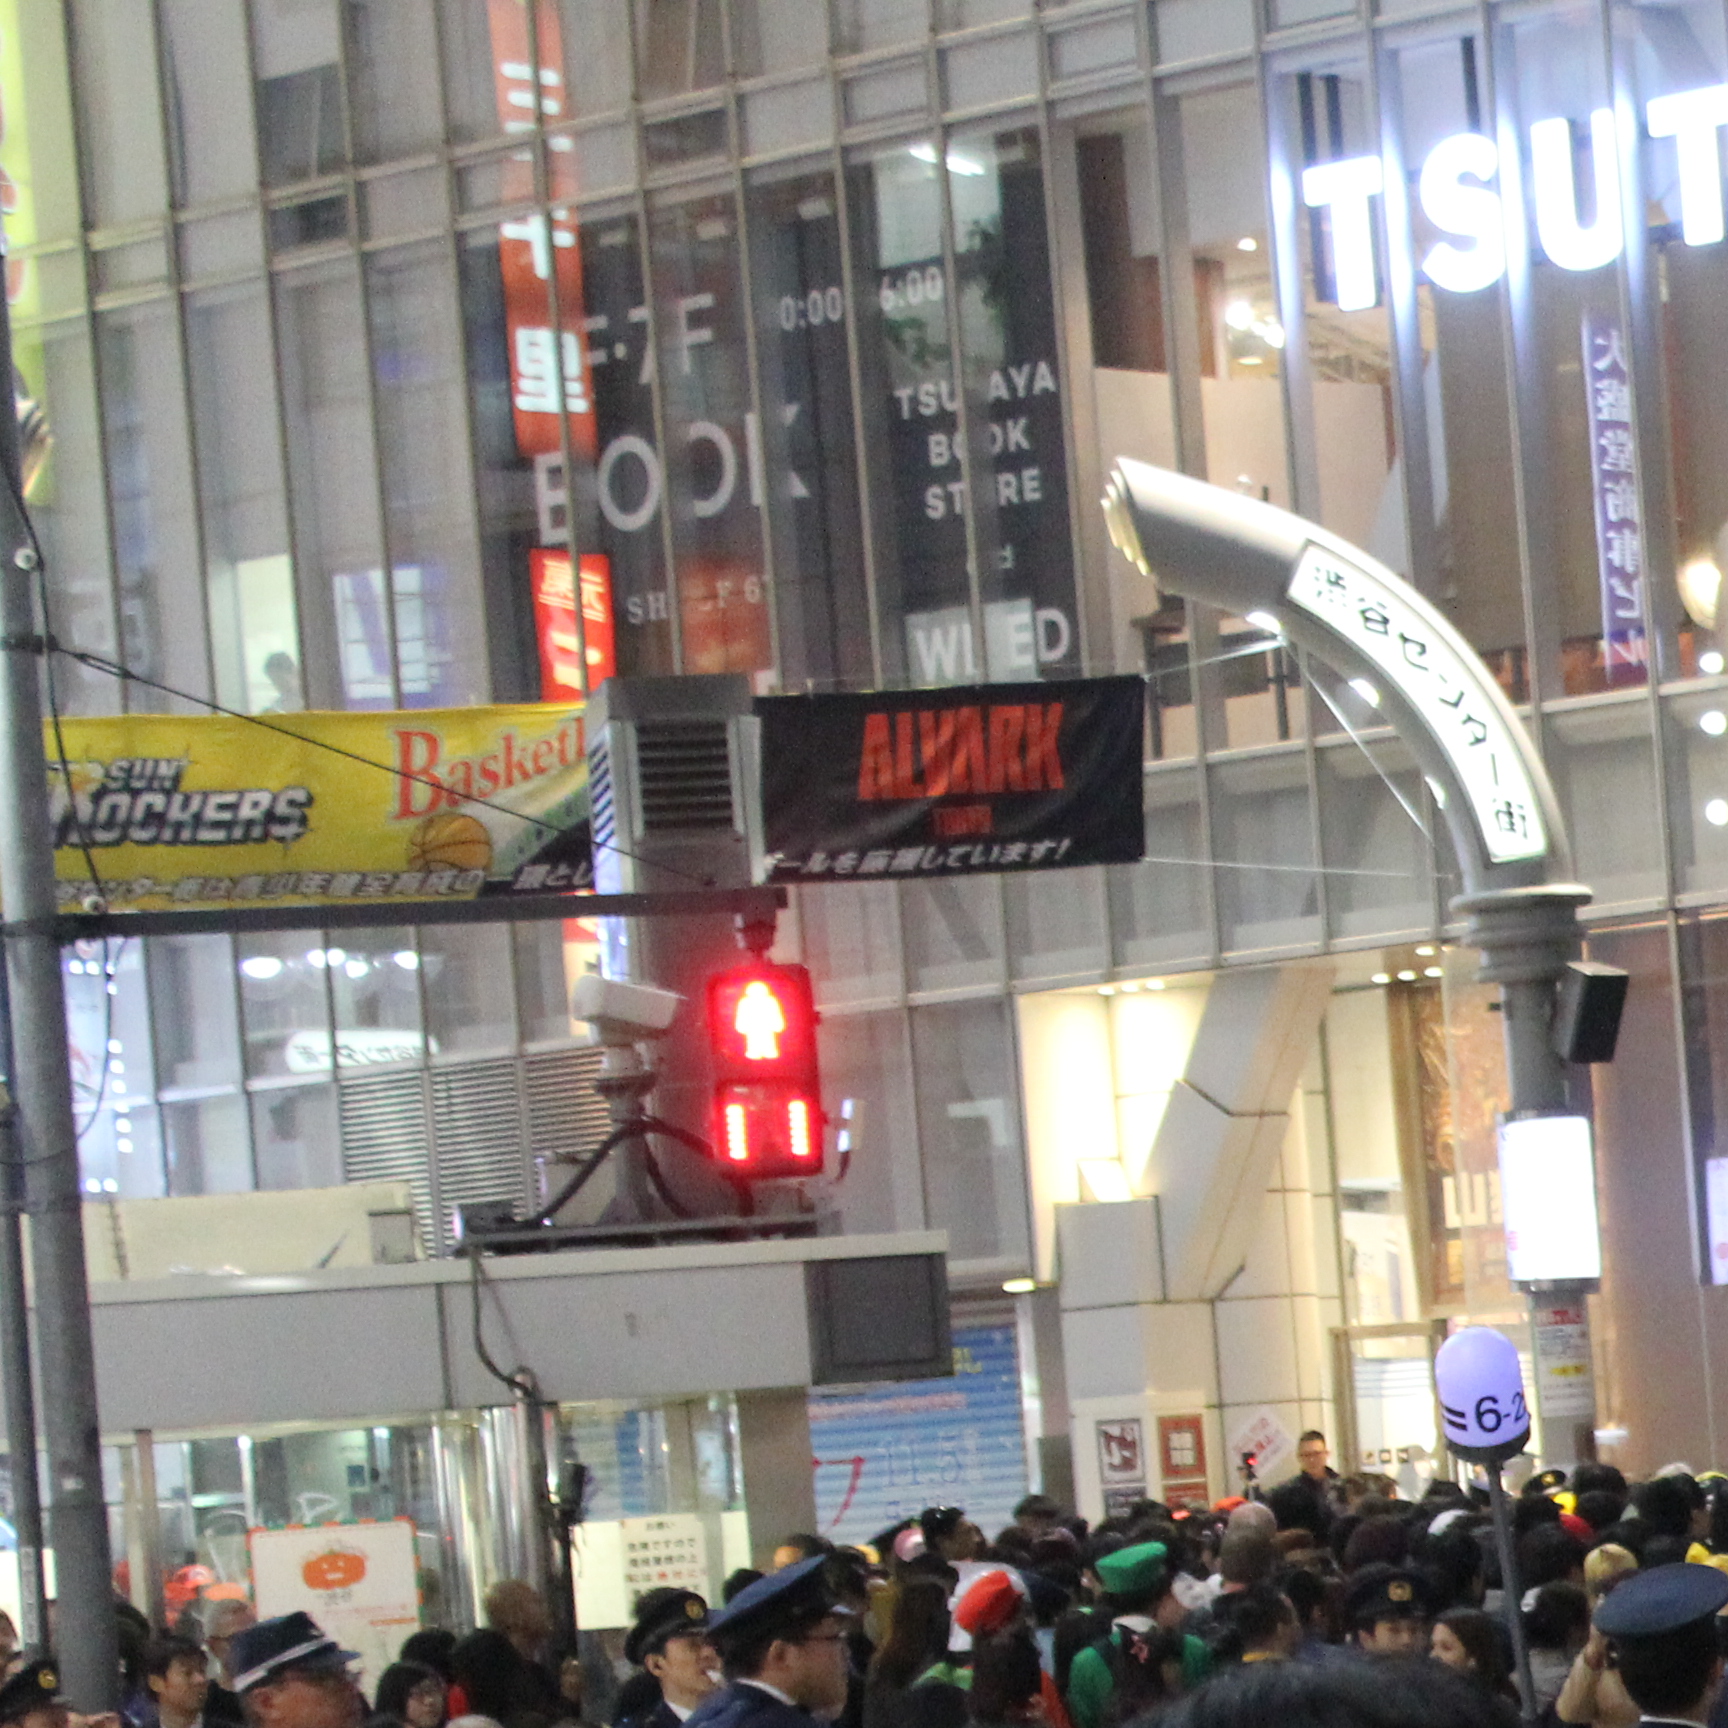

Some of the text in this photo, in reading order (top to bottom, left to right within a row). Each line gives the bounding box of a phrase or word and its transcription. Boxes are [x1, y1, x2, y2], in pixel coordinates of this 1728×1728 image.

[893, 361, 1057, 420] TSUAYA
[924, 468, 1042, 519] STRE
[914, 609, 1071, 683] WIED
[1312, 564, 1529, 842] 渋谷センター街
[106, 758, 185, 791] SUN
[857, 702, 1065, 801] ALVARK
[1474, 1391, 1527, 1433] 6-2
